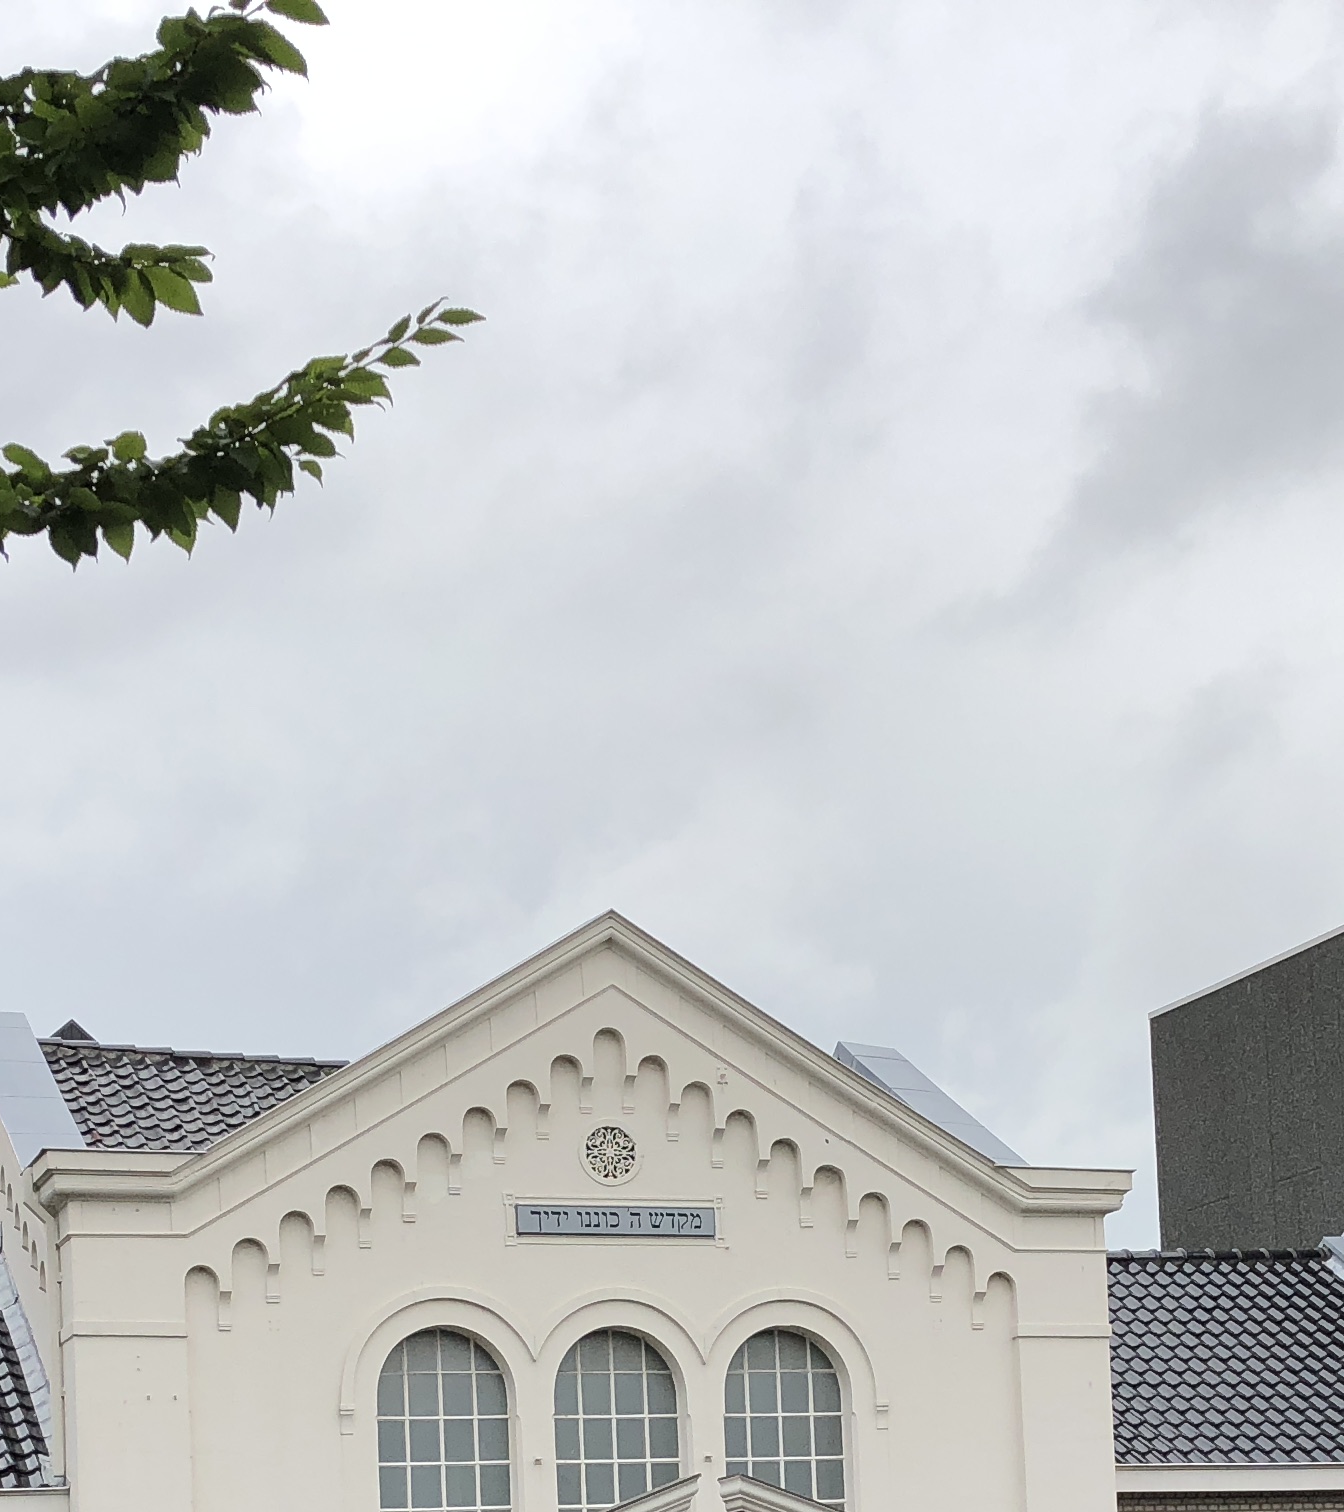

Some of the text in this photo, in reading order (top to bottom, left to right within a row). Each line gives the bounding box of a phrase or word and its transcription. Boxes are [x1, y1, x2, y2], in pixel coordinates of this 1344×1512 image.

[530, 1209, 569, 1232] ידיך
[576, 1210, 620, 1229] כוננו
[648, 1211, 703, 1233] מקדש
